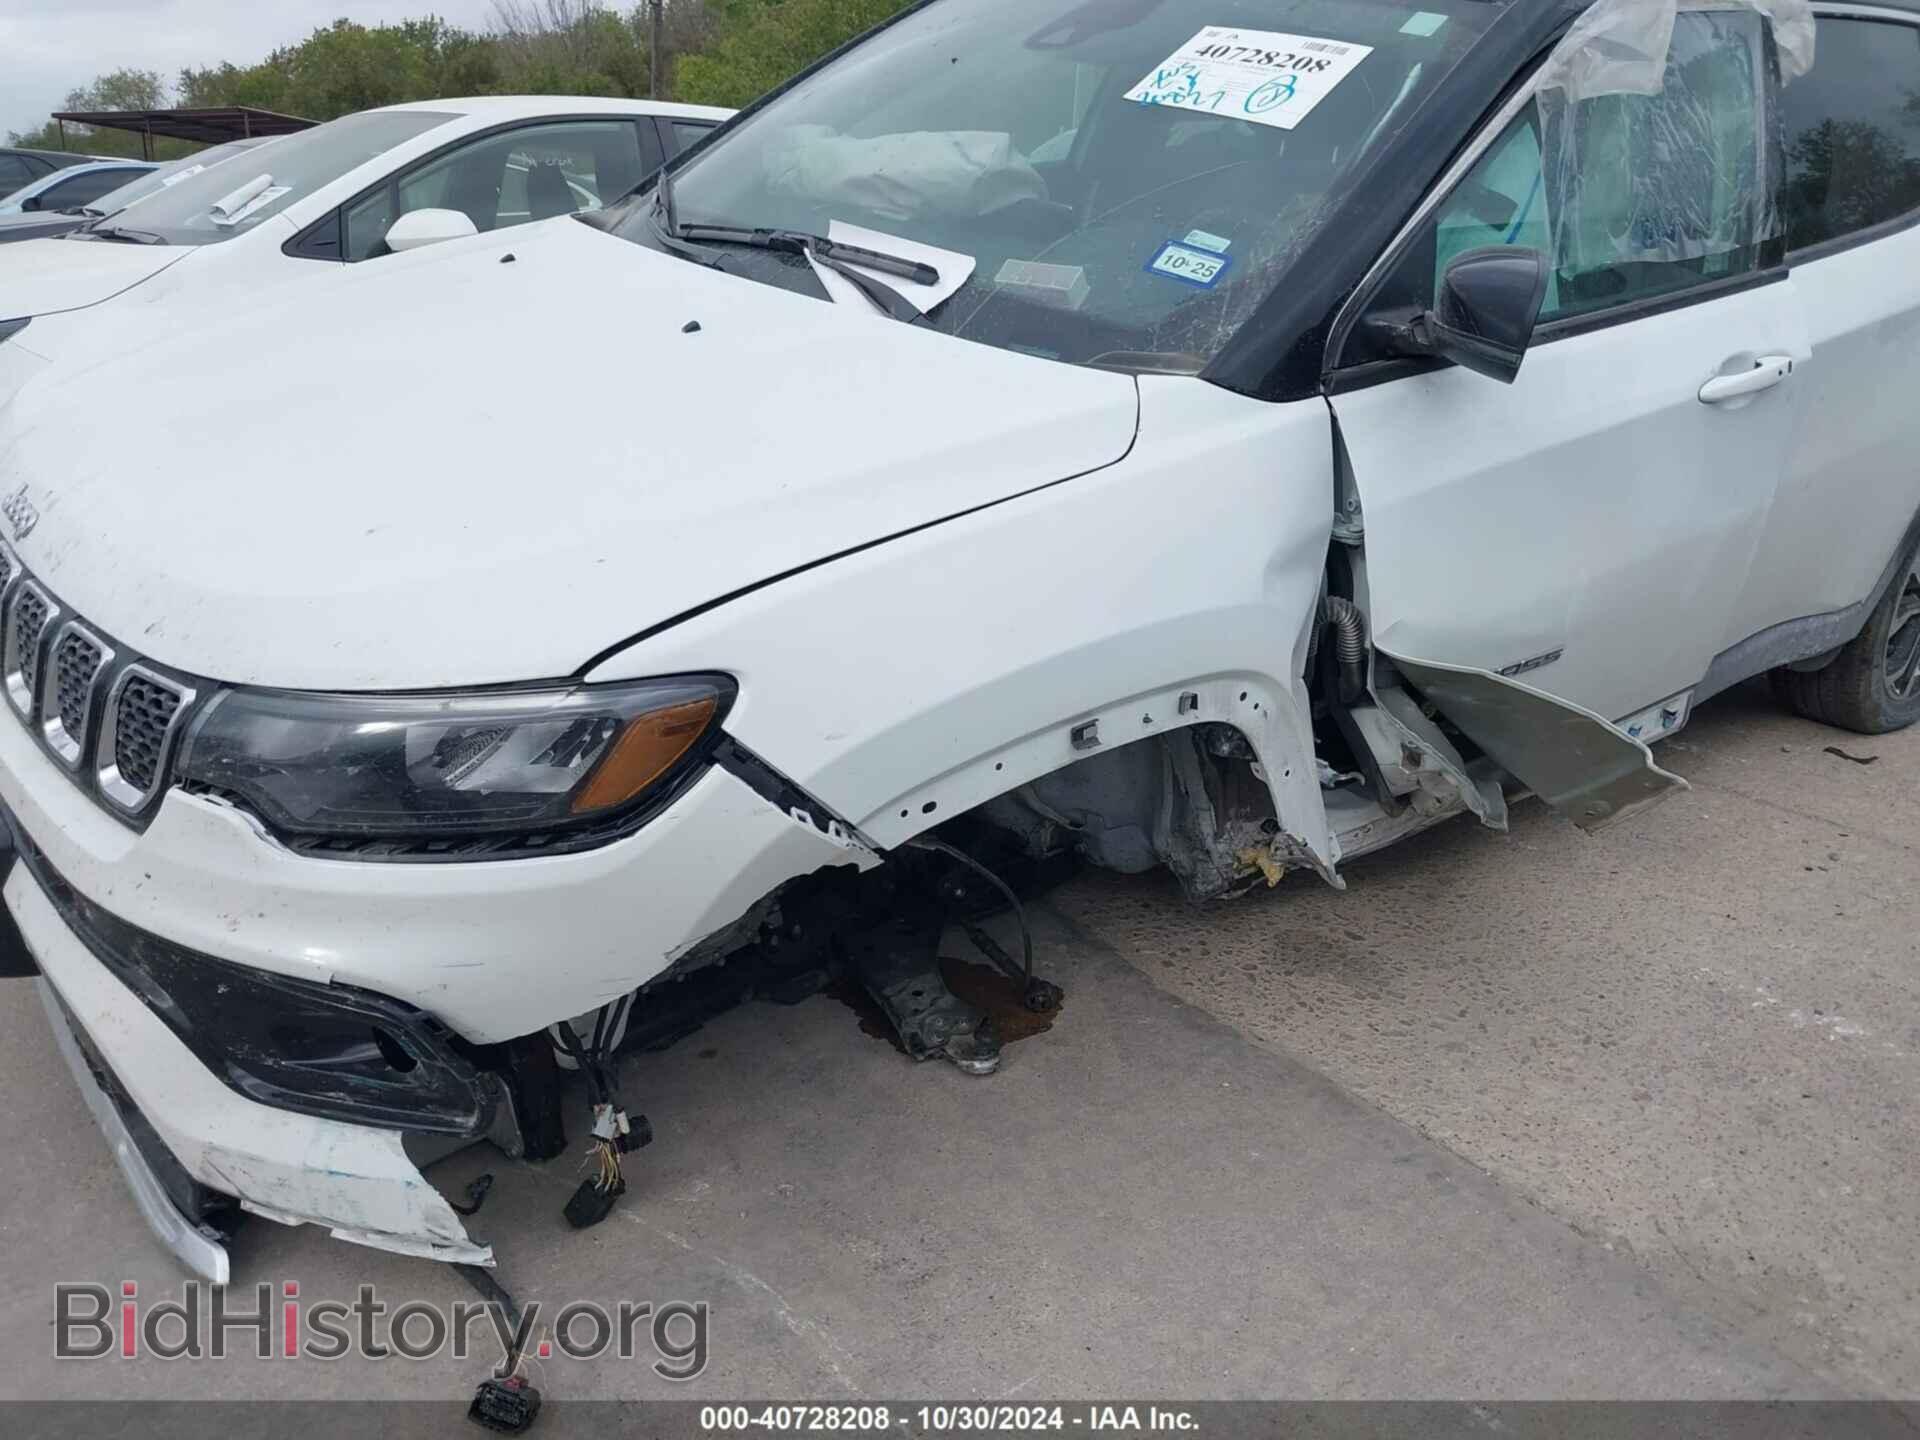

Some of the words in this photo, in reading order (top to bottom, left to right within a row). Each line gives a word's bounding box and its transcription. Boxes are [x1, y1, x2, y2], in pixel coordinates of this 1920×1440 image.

[1194, 42, 1332, 73] 40728208
[1163, 254, 1186, 269] 10
[1190, 262, 1217, 278] 25
